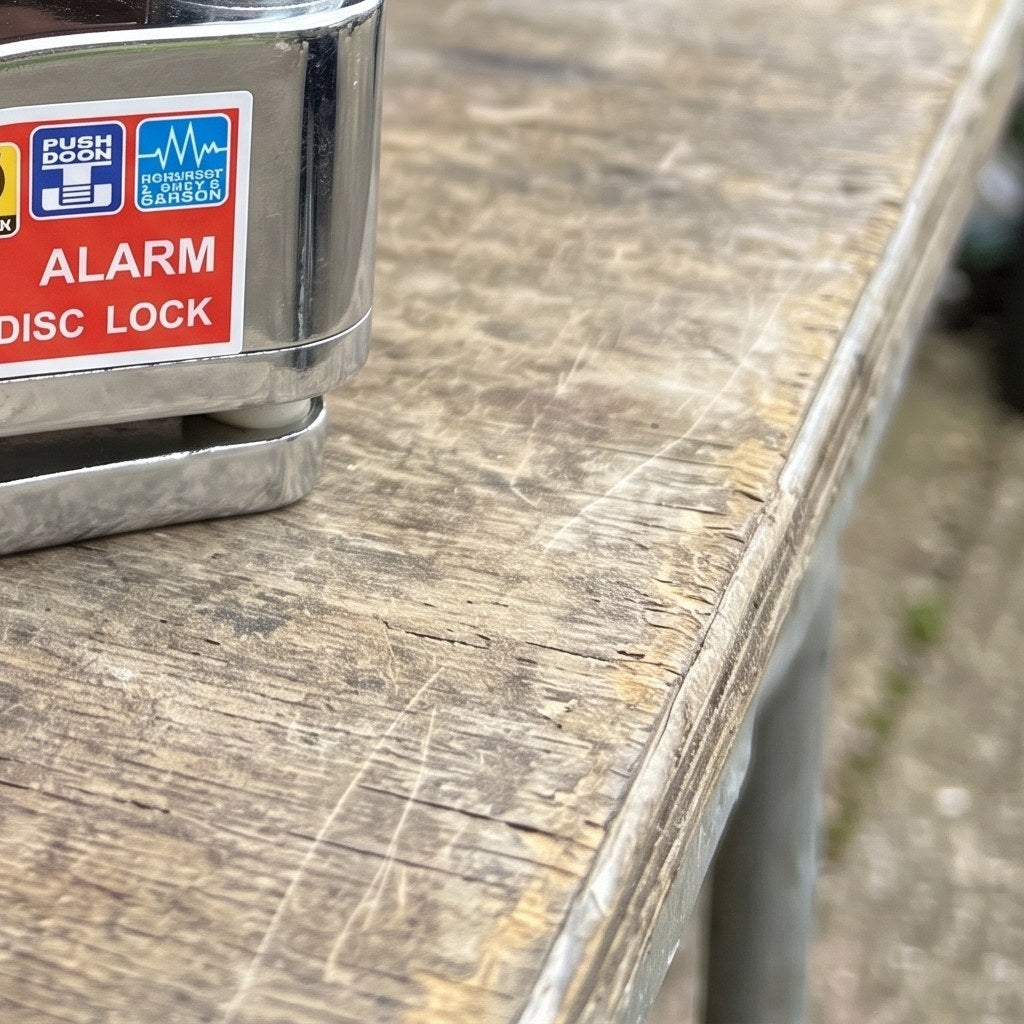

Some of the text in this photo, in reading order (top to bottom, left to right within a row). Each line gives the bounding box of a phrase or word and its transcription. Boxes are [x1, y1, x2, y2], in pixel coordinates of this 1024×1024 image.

[43, 134, 112, 152] PUSH
[38, 235, 216, 287] ALARM
[106, 296, 213, 335] LOCK
